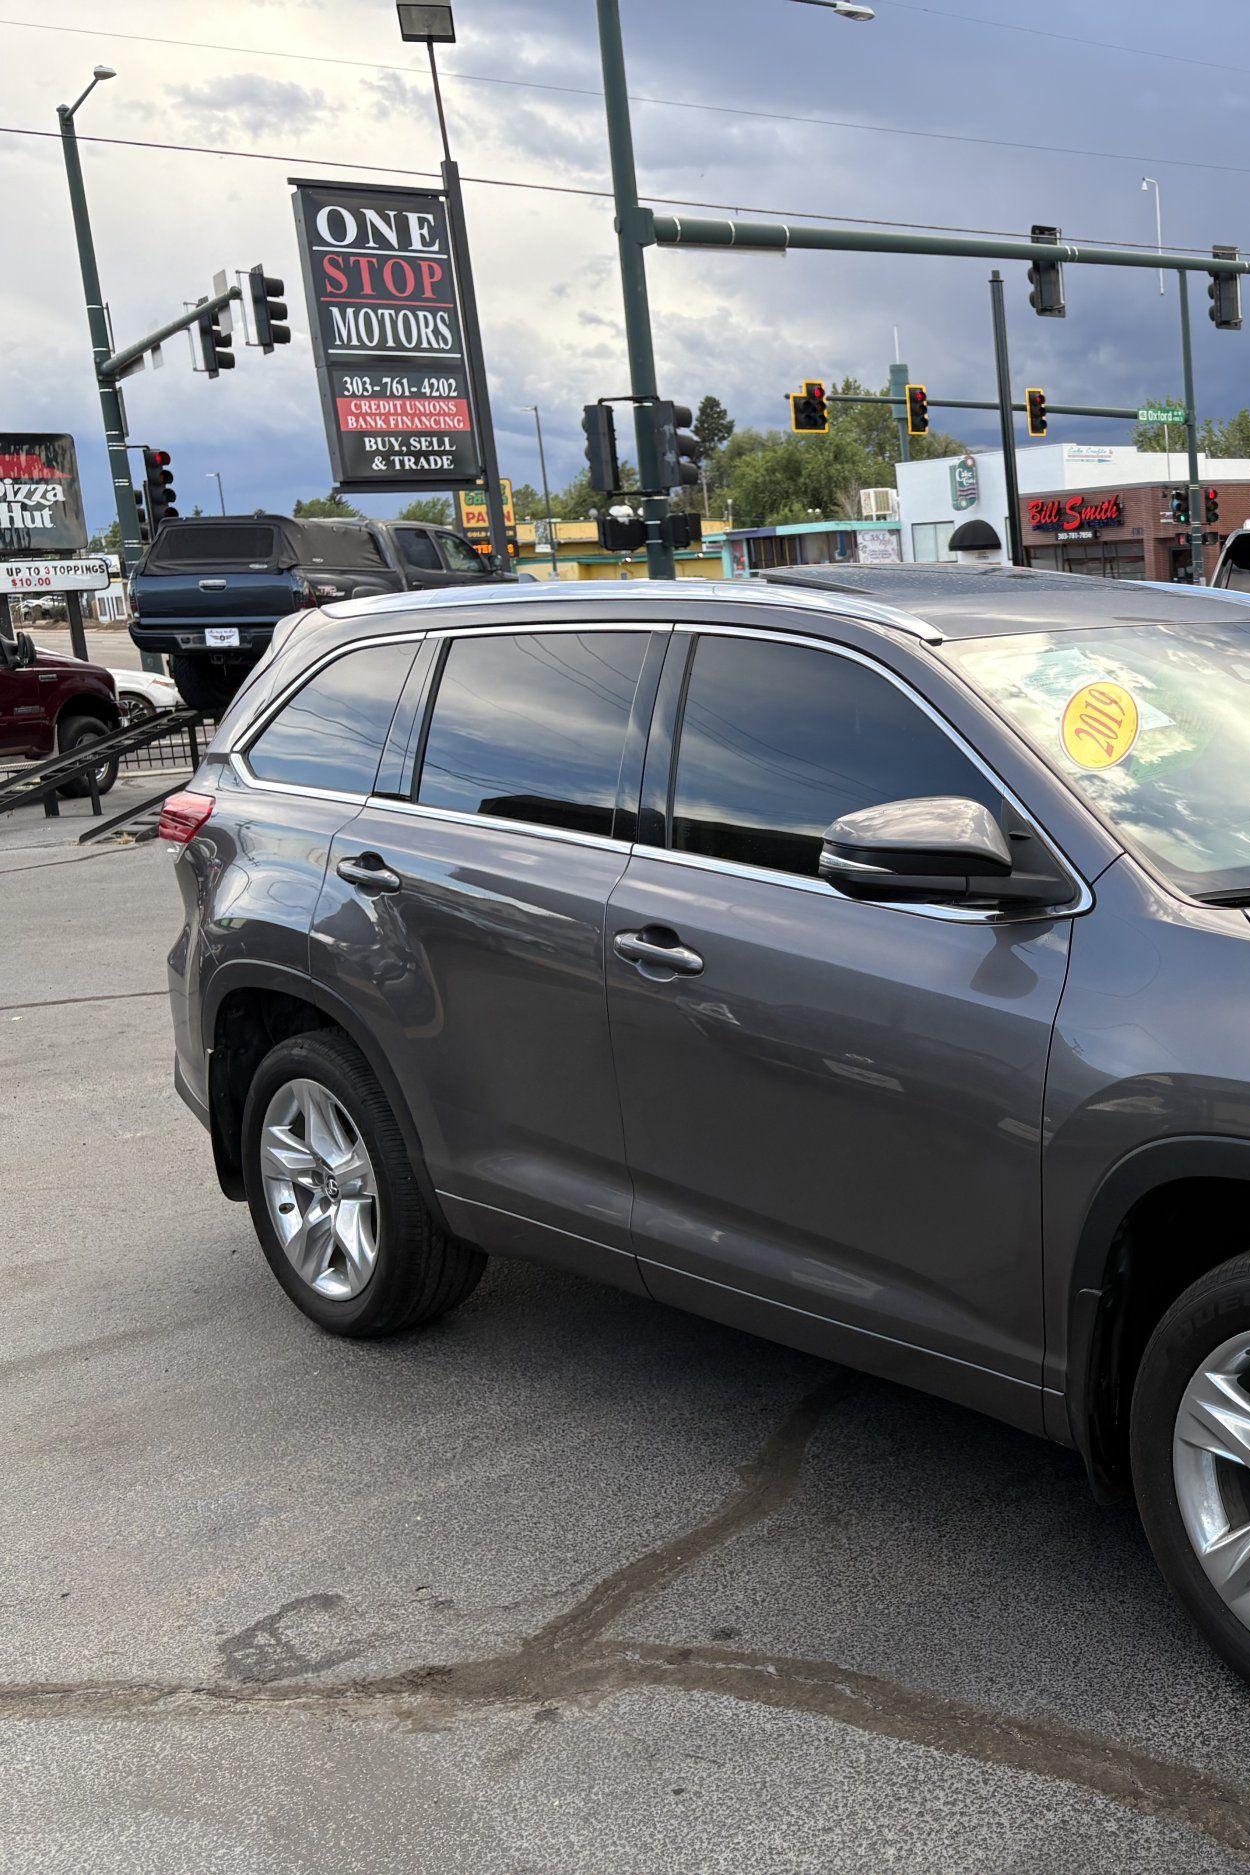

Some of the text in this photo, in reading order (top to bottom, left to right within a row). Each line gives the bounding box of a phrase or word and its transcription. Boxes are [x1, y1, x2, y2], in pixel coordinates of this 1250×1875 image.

[316, 206, 439, 251] ONE
[323, 255, 442, 298] STOP
[329, 307, 452, 349] MOTORS
[351, 401, 456, 414] CREDIT UNIONS
[347, 416, 464, 429] BANK FINANCING
[1148, 410, 1172, 421] Oxford
[363, 437, 456, 453] BUY, SELL
[372, 456, 454, 470] & TRADE
[1028, 494, 1119, 530] Bill Smith
[6, 564, 105, 577] UP TO 3 TOPPINGS
[11, 577, 51, 587] $10.00
[1075, 689, 1125, 758] 2019
